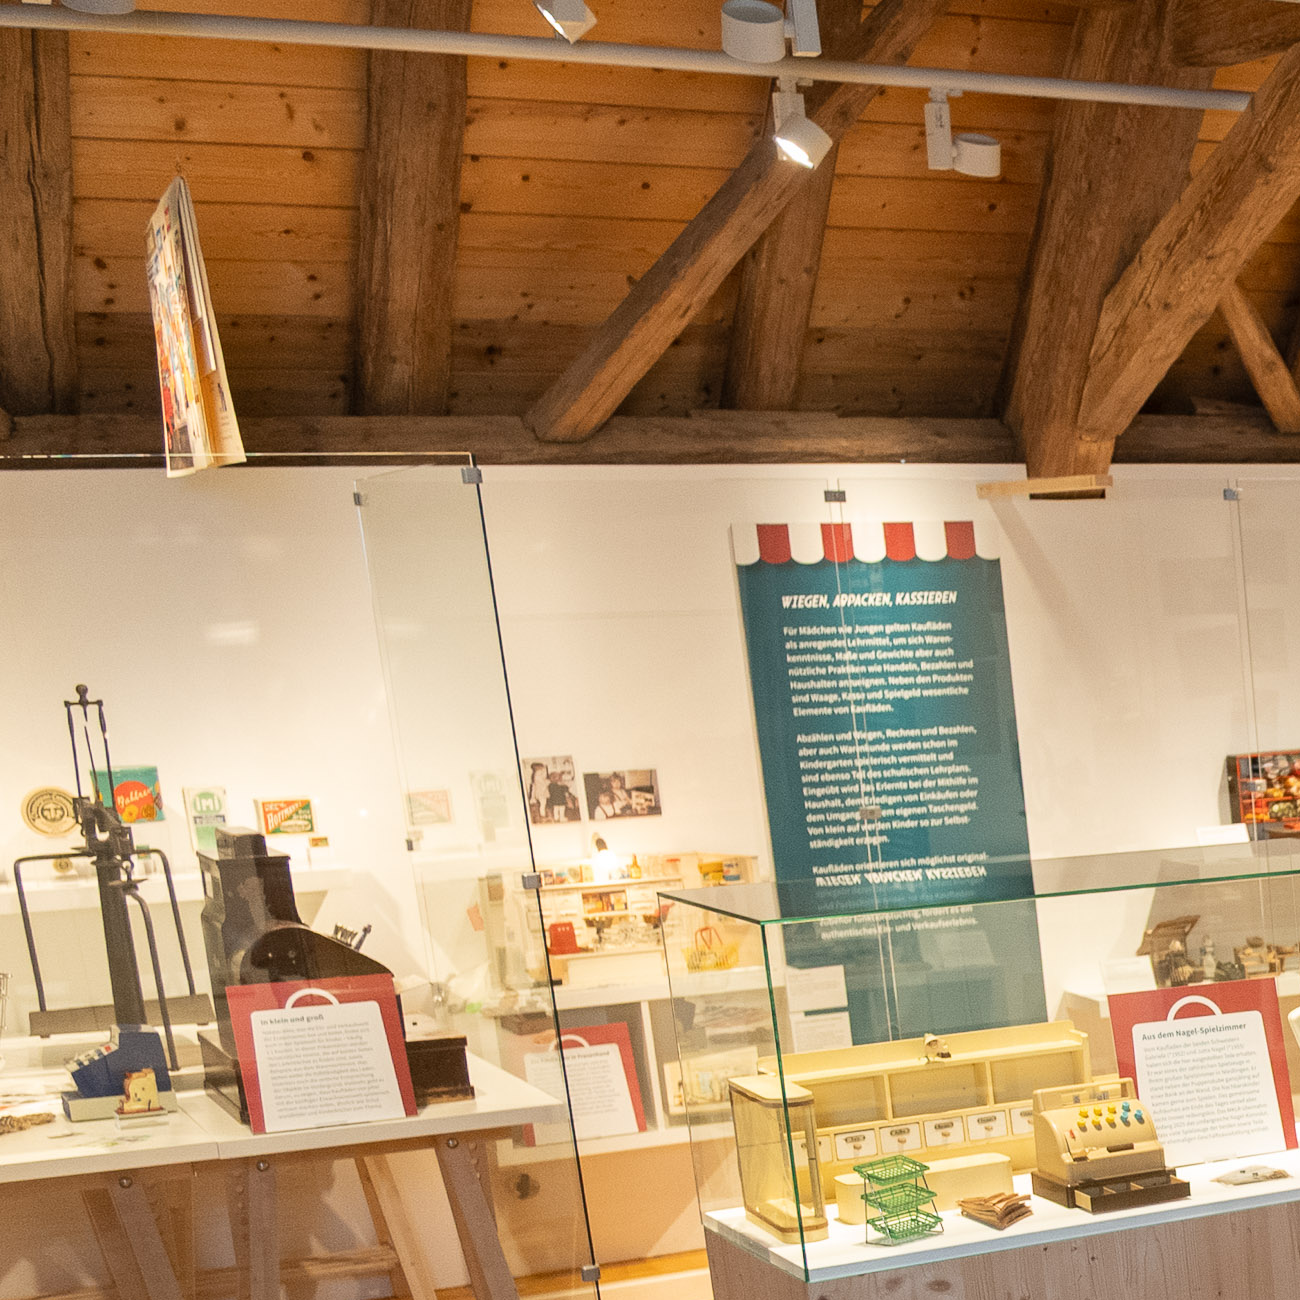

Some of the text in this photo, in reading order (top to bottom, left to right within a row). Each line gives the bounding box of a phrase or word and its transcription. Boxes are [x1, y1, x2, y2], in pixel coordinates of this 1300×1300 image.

[782, 594, 829, 608] WIEGEN,
[895, 591, 957, 605] KASSIEREN
[270, 1016, 289, 1025] klein
[290, 1014, 305, 1023] und
[1142, 1023, 1247, 1041] Aus dem Nagel-Spielzimmer
